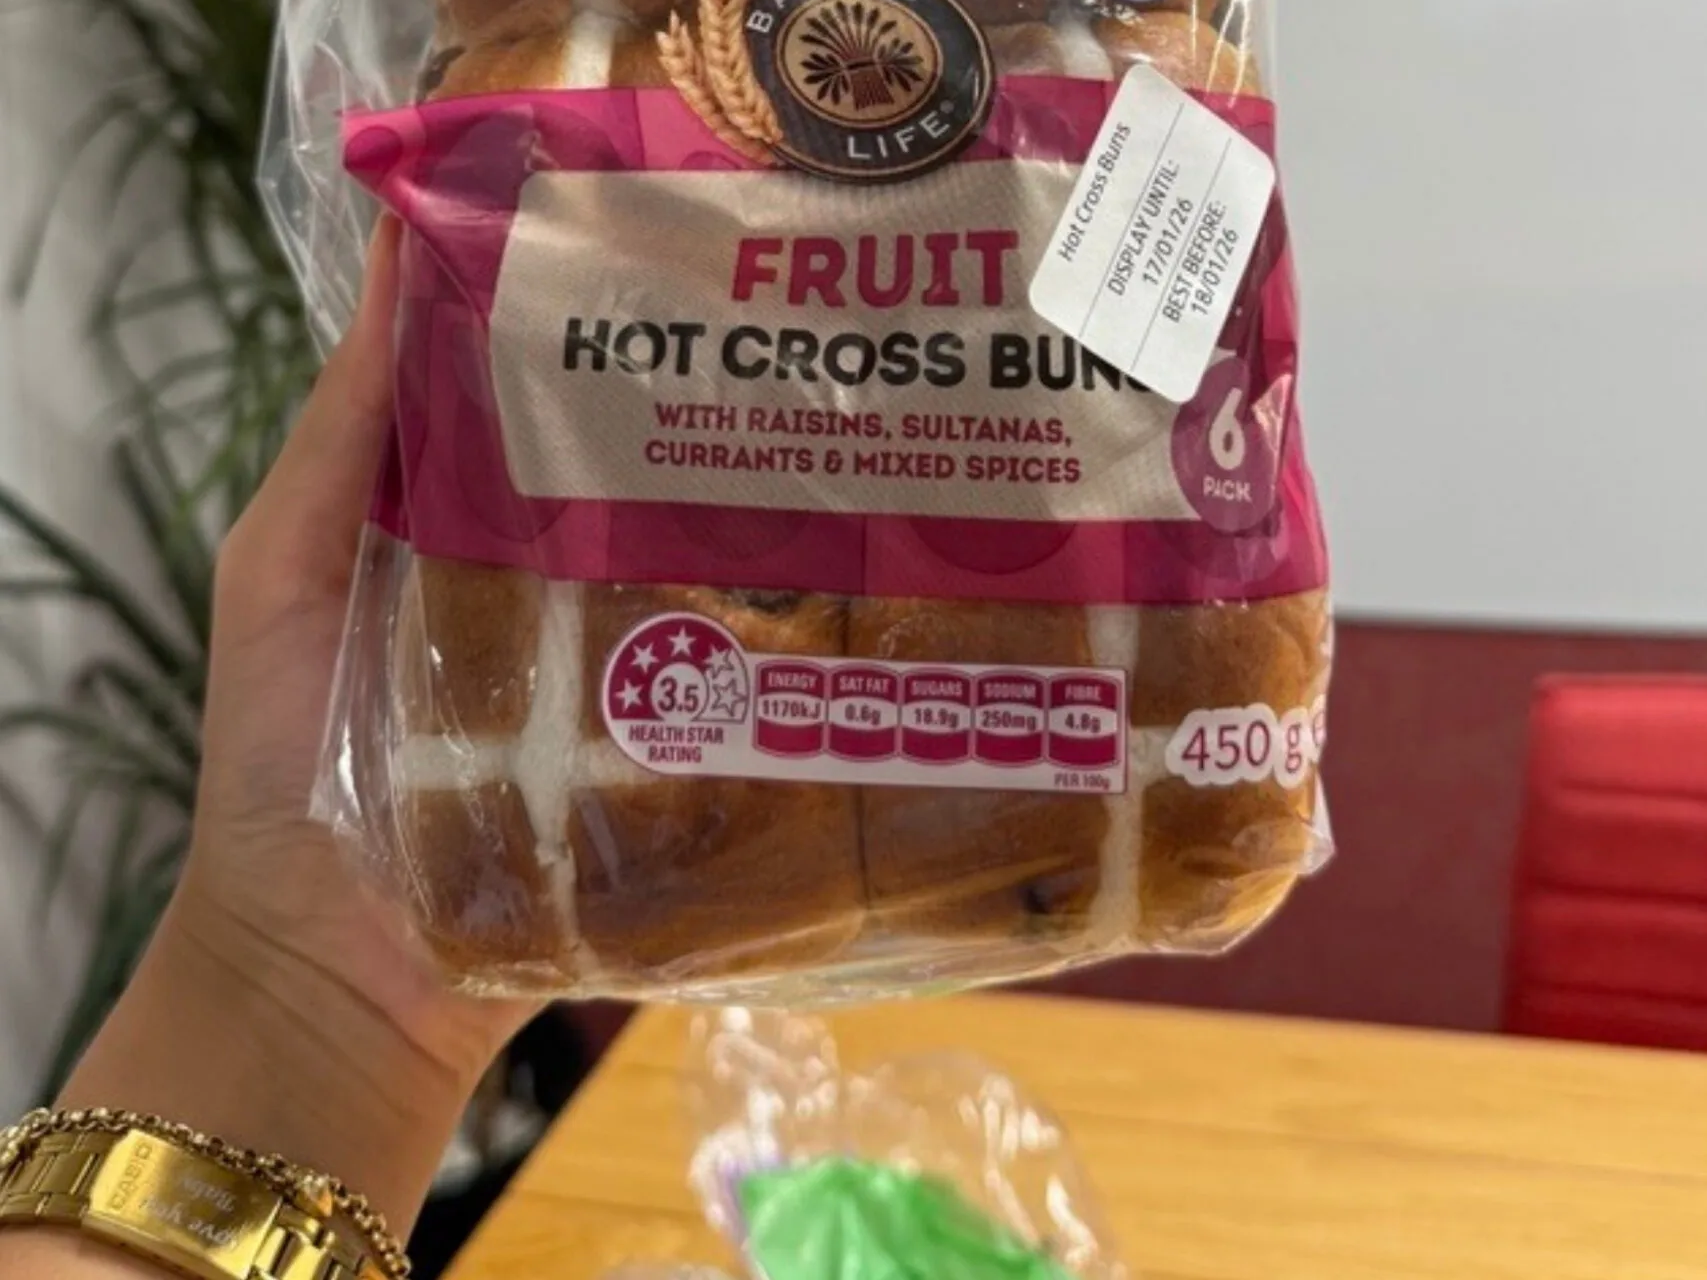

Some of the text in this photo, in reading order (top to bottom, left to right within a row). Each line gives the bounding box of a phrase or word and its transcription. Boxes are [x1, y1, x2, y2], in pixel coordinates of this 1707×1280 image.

[847, 110, 951, 161] LIFE
[1058, 121, 1131, 262] Hot Cross Buns
[1107, 159, 1180, 297] DISPLAY UNTIL:
[1142, 196, 1194, 286] 17/01/26
[731, 229, 1020, 310] FRUIT
[1162, 199, 1228, 323] BEST BEFORE:
[1190, 226, 1240, 316] 18/01/26
[562, 317, 1152, 393] HOT CROSS BUN
[654, 402, 1072, 448] WITH RAISINS, SULTANAS,
[1208, 387, 1246, 471] 6
[644, 438, 1082, 484] CURRANTS & MIXED SPICES
[1202, 475, 1253, 502] PACK
[657, 675, 700, 713] 3.5
[767, 671, 818, 691] ENERGY
[838, 674, 890, 694] SAT FAT
[910, 679, 964, 697] SUGARS
[982, 682, 1037, 700] SODIUM
[1064, 683, 1101, 702] FIBRE
[761, 699, 822, 720] 1170kJ
[981, 708, 1038, 733] 250mg
[628, 723, 724, 744] HEALTH STAR
[647, 745, 703, 763] RATING
[1181, 719, 1271, 772] 450
[1285, 722, 1304, 775] g
[1053, 772, 1081, 788] PER
[107, 1141, 153, 1212] CASIO
